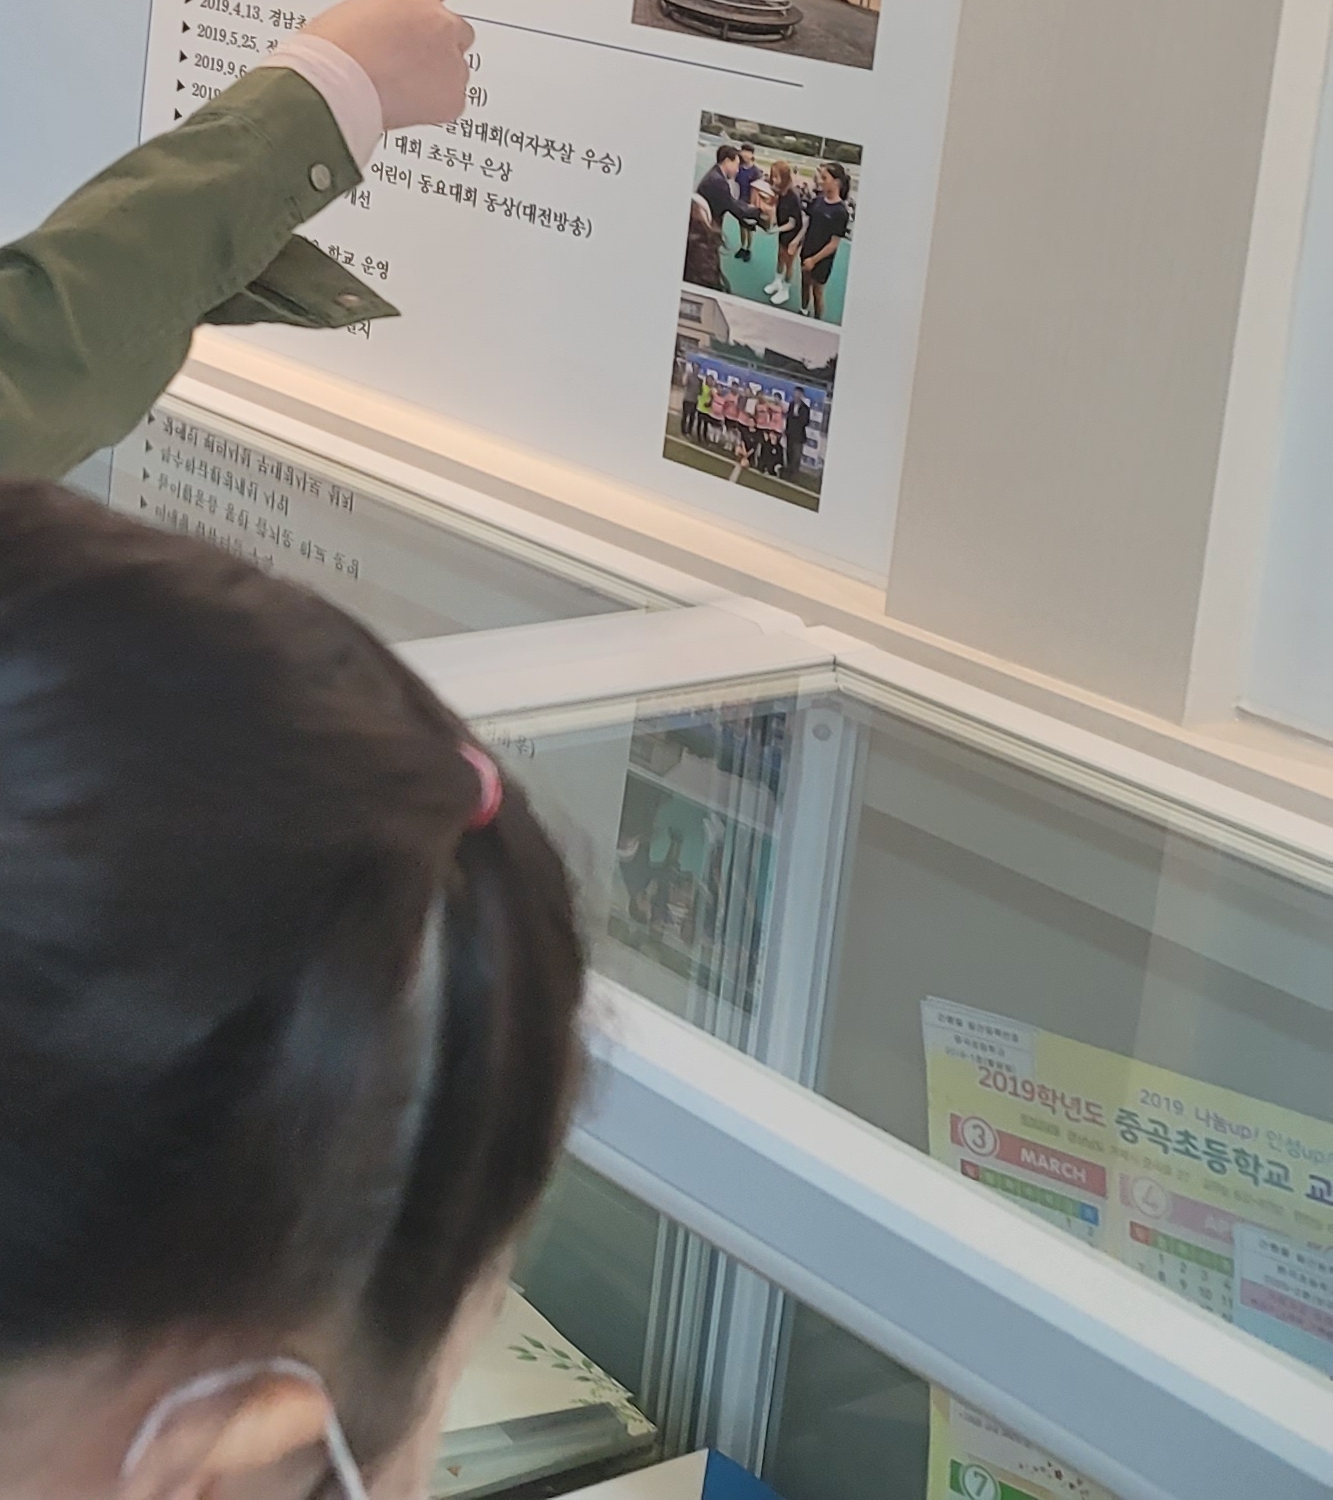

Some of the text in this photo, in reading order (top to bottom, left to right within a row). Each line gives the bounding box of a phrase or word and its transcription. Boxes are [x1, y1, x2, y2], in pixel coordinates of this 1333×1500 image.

[197, 23, 260, 53] 2019.5.25.
[394, 135, 514, 183] 대회 초등부 은상
[580, 146, 624, 176] 우승)
[370, 161, 594, 240] 어린이 동요대회 동상(대전방송)
[1019, 1146, 1087, 1184] MARCH
[1114, 1107, 1295, 1194] 중곡초등학교
